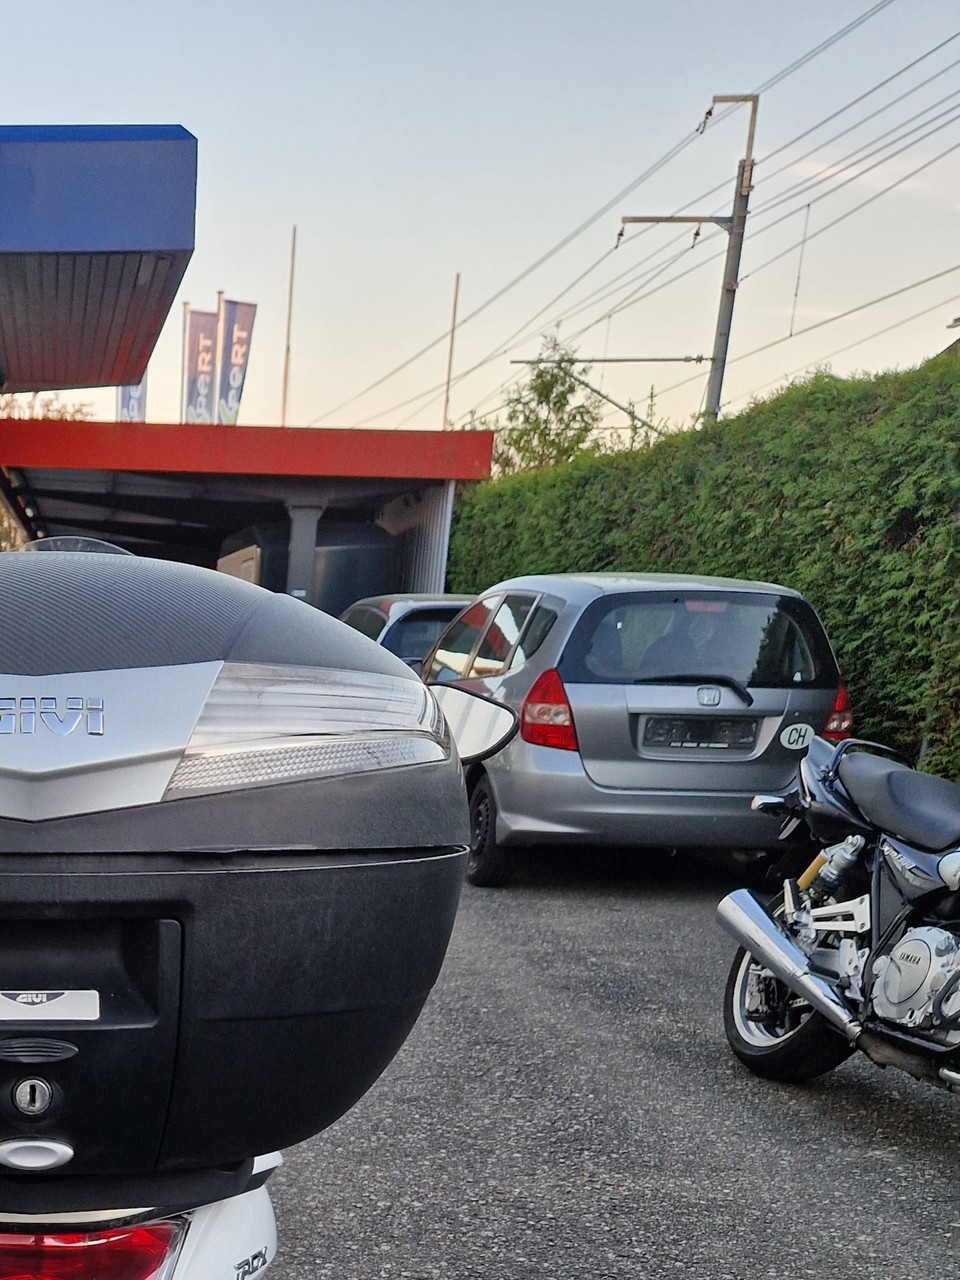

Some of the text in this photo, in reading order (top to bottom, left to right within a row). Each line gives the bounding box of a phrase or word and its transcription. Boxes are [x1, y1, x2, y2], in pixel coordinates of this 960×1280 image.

[787, 728, 809, 746] CH
[899, 952, 921, 965] YAMAHA
[16, 993, 47, 1004] GIVI
